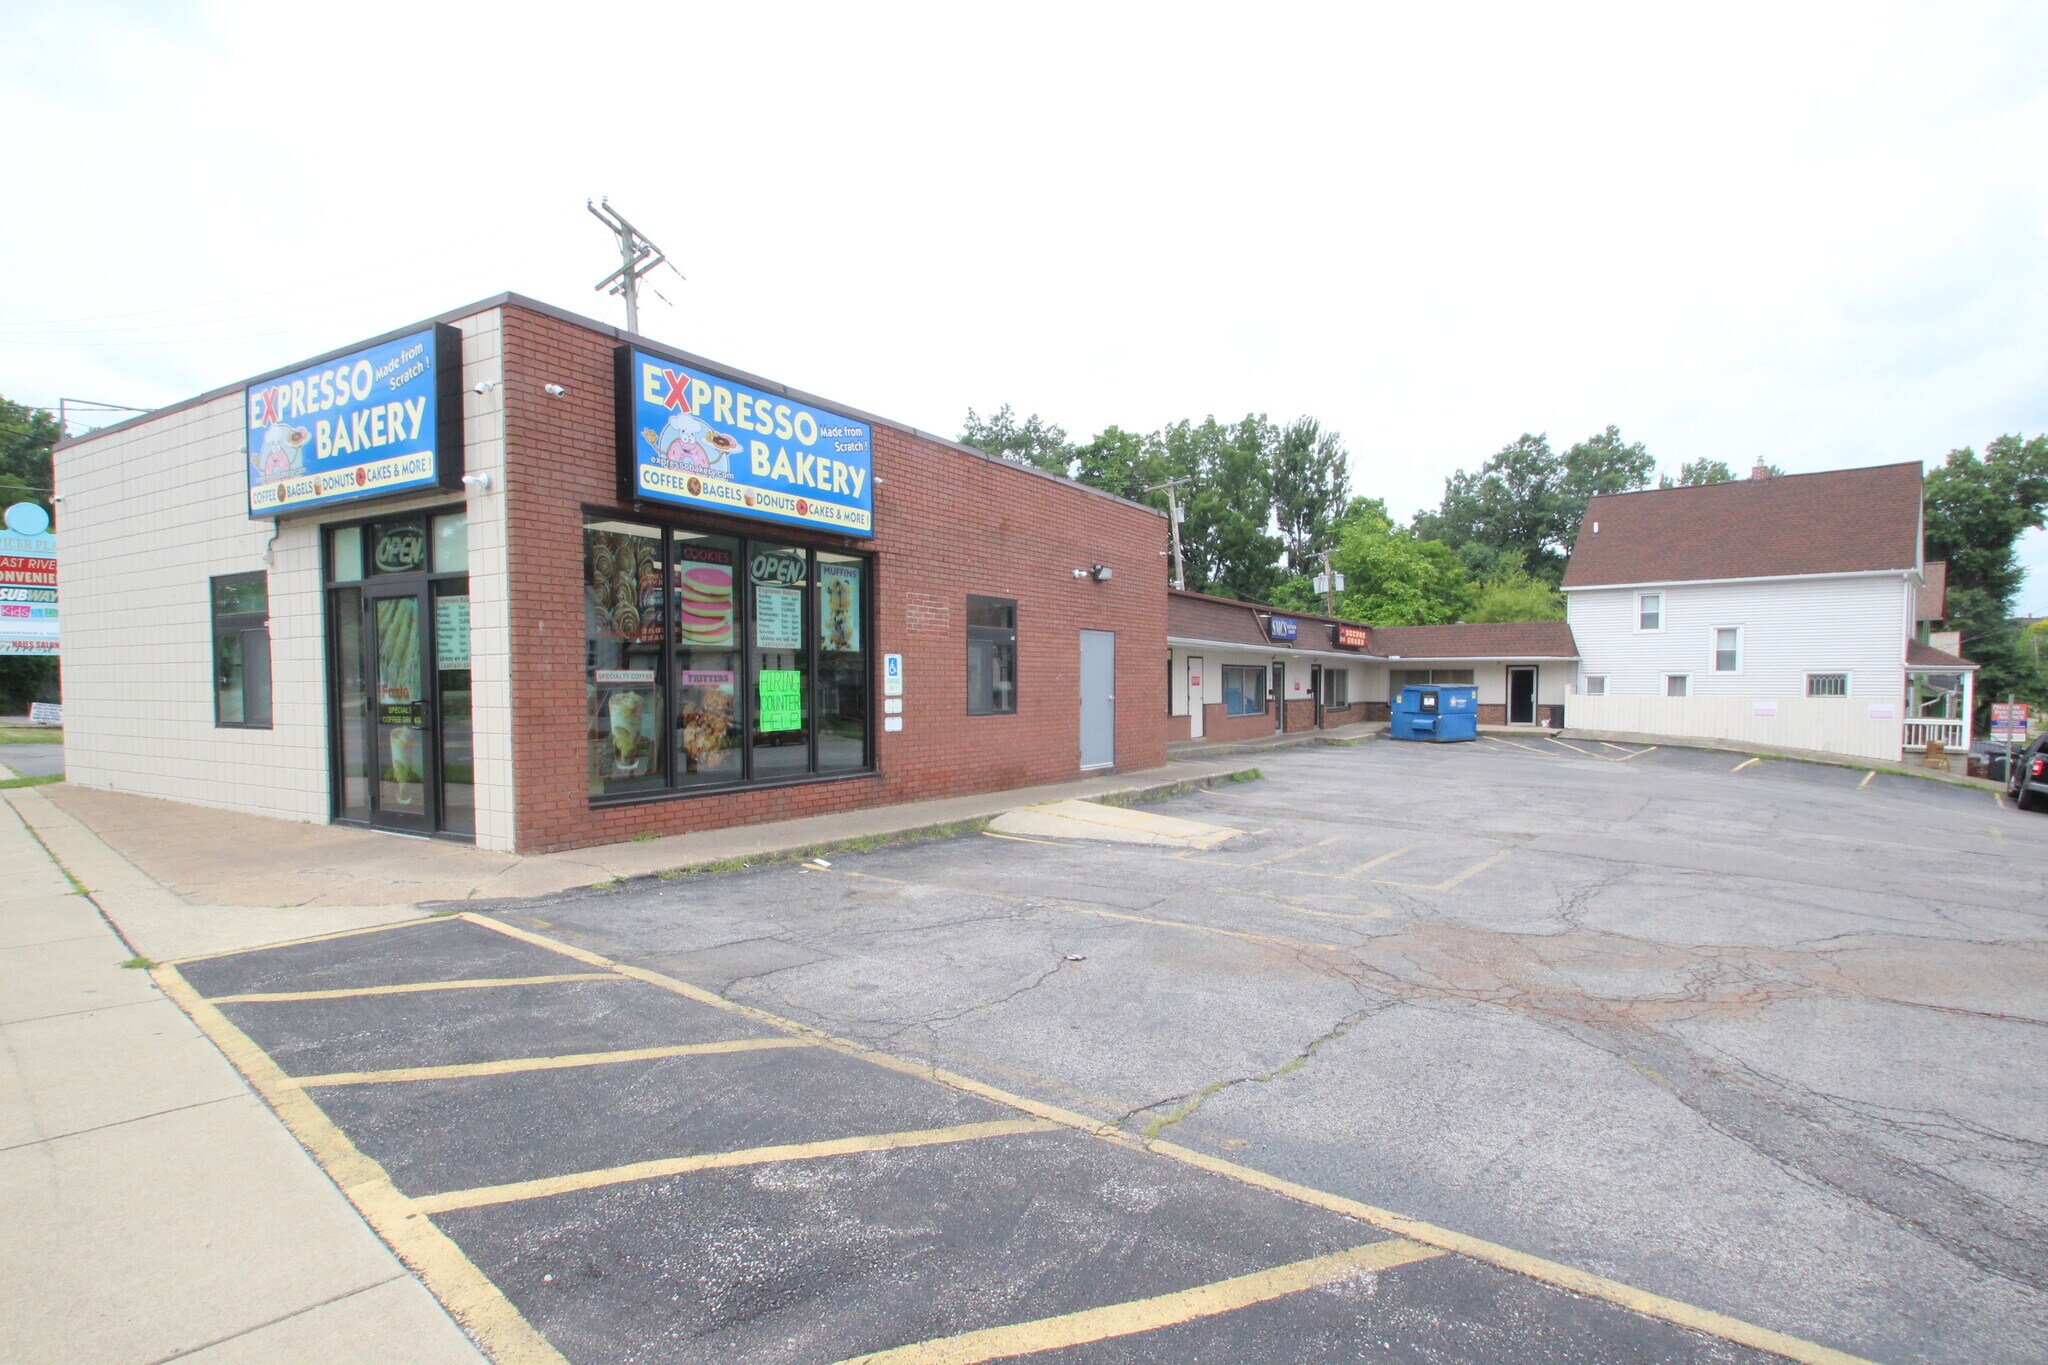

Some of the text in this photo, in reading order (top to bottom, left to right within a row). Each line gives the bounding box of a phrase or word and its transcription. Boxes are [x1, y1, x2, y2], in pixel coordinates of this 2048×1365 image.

[376, 342, 423, 381] Made from
[390, 364, 424, 391] Scratch
[251, 360, 373, 429] EXPRESSO
[642, 363, 818, 446] EXPRESSO
[316, 396, 426, 460] BAKERY
[820, 425, 863, 438] Made from
[834, 441, 864, 453] Scratch
[651, 456, 735, 481] expressobakery.com
[750, 440, 866, 499] BAKERY
[253, 489, 277, 504] COFFEE
[286, 480, 313, 497] BAGELS
[322, 472, 355, 487] DONUTS
[367, 465, 392, 482] CAKES
[394, 464, 400, 477] &
[402, 460, 426, 476] MORE
[643, 470, 685, 491] COFFEE
[702, 482, 742, 501] BAGELS
[756, 493, 796, 511] DONUTS
[808, 503, 834, 519] CAKES
[836, 509, 842, 520] &
[843, 511, 865, 525] MORE
[379, 536, 424, 563] OPEN
[683, 548, 730, 563] COOKIES
[752, 555, 801, 583] OPEN
[824, 566, 857, 578] MUFFINS
[0, 588, 58, 602] SUBWAY
[2, 606, 29, 617] Kids
[1346, 630, 1366, 639] SECURE
[1347, 637, 1364, 646] GUARD
[12, 641, 35, 649] NAILS
[36, 641, 60, 649] SALON
[688, 674, 729, 683] FRITTERS
[761, 672, 800, 692] HIRING
[388, 706, 412, 714] SPECIALT
[761, 694, 800, 712] COUNTER
[761, 712, 799, 730] HELP
